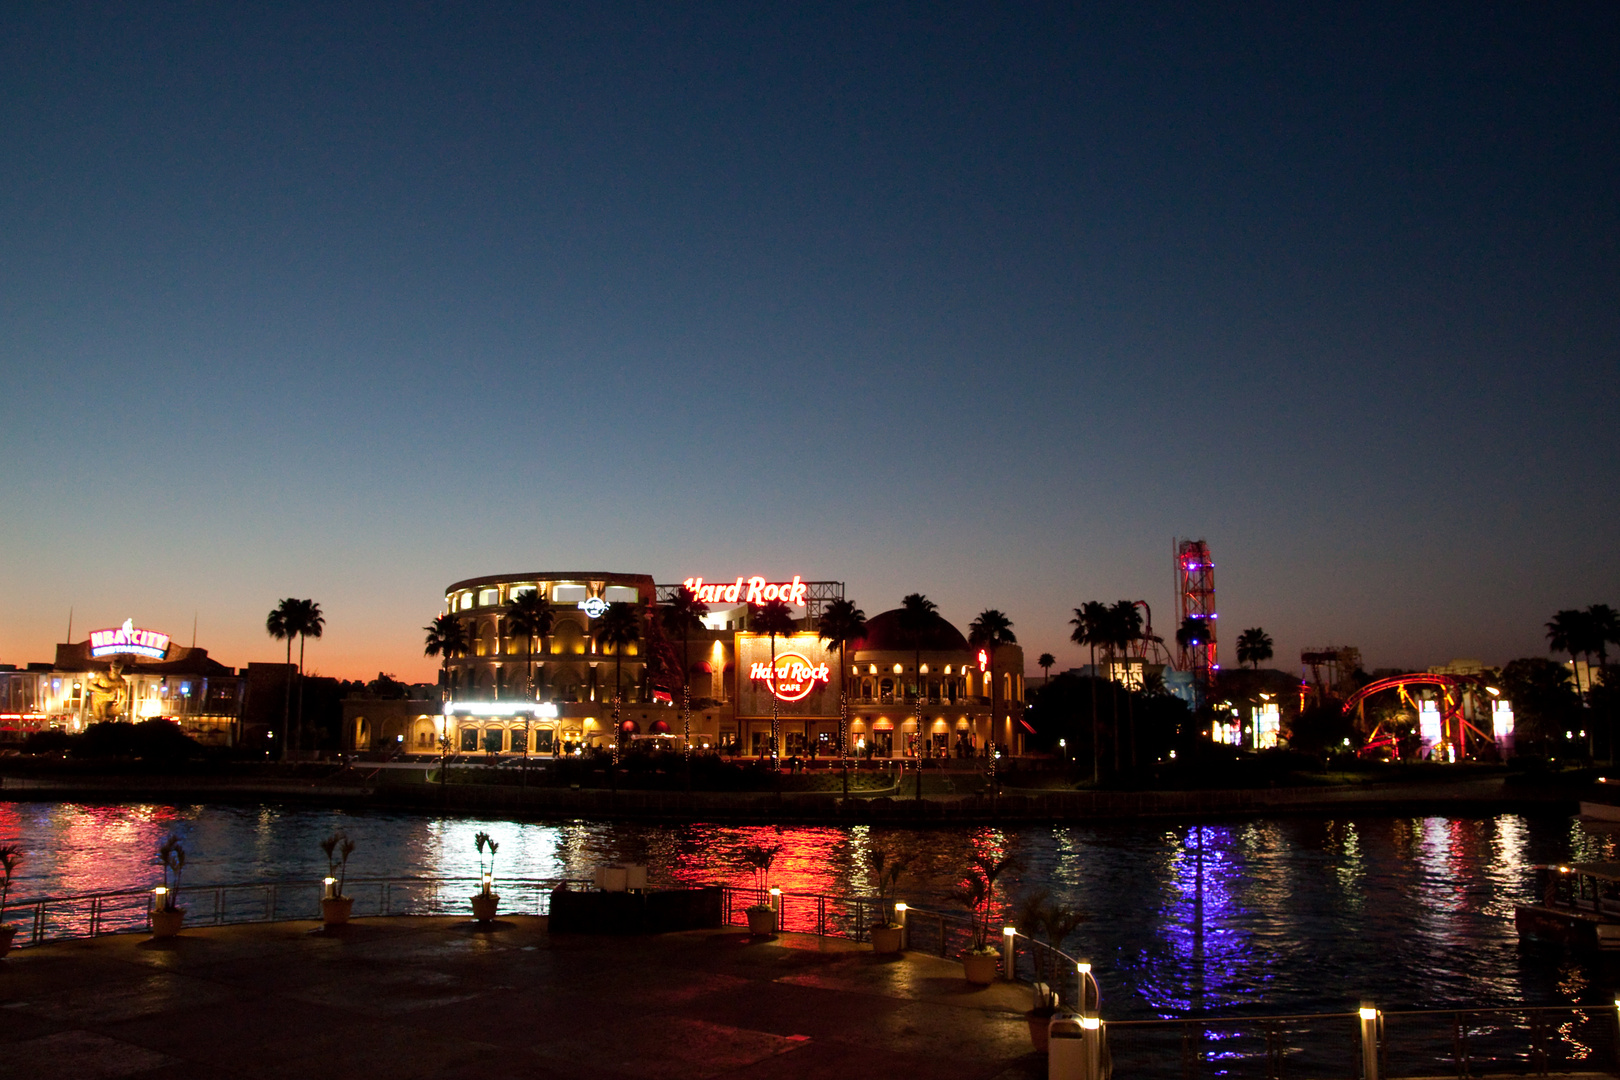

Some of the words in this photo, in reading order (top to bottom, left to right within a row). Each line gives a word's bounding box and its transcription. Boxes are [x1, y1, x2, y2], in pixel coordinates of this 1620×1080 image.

[683, 576, 744, 602] Hard
[746, 575, 807, 606] Rock
[90, 629, 126, 648] NBA
[131, 629, 169, 650] CITY
[750, 662, 790, 679] Hard
[791, 662, 829, 683] Rock
[1110, 662, 1143, 673] BLUE
[779, 683, 801, 692] CAFE
